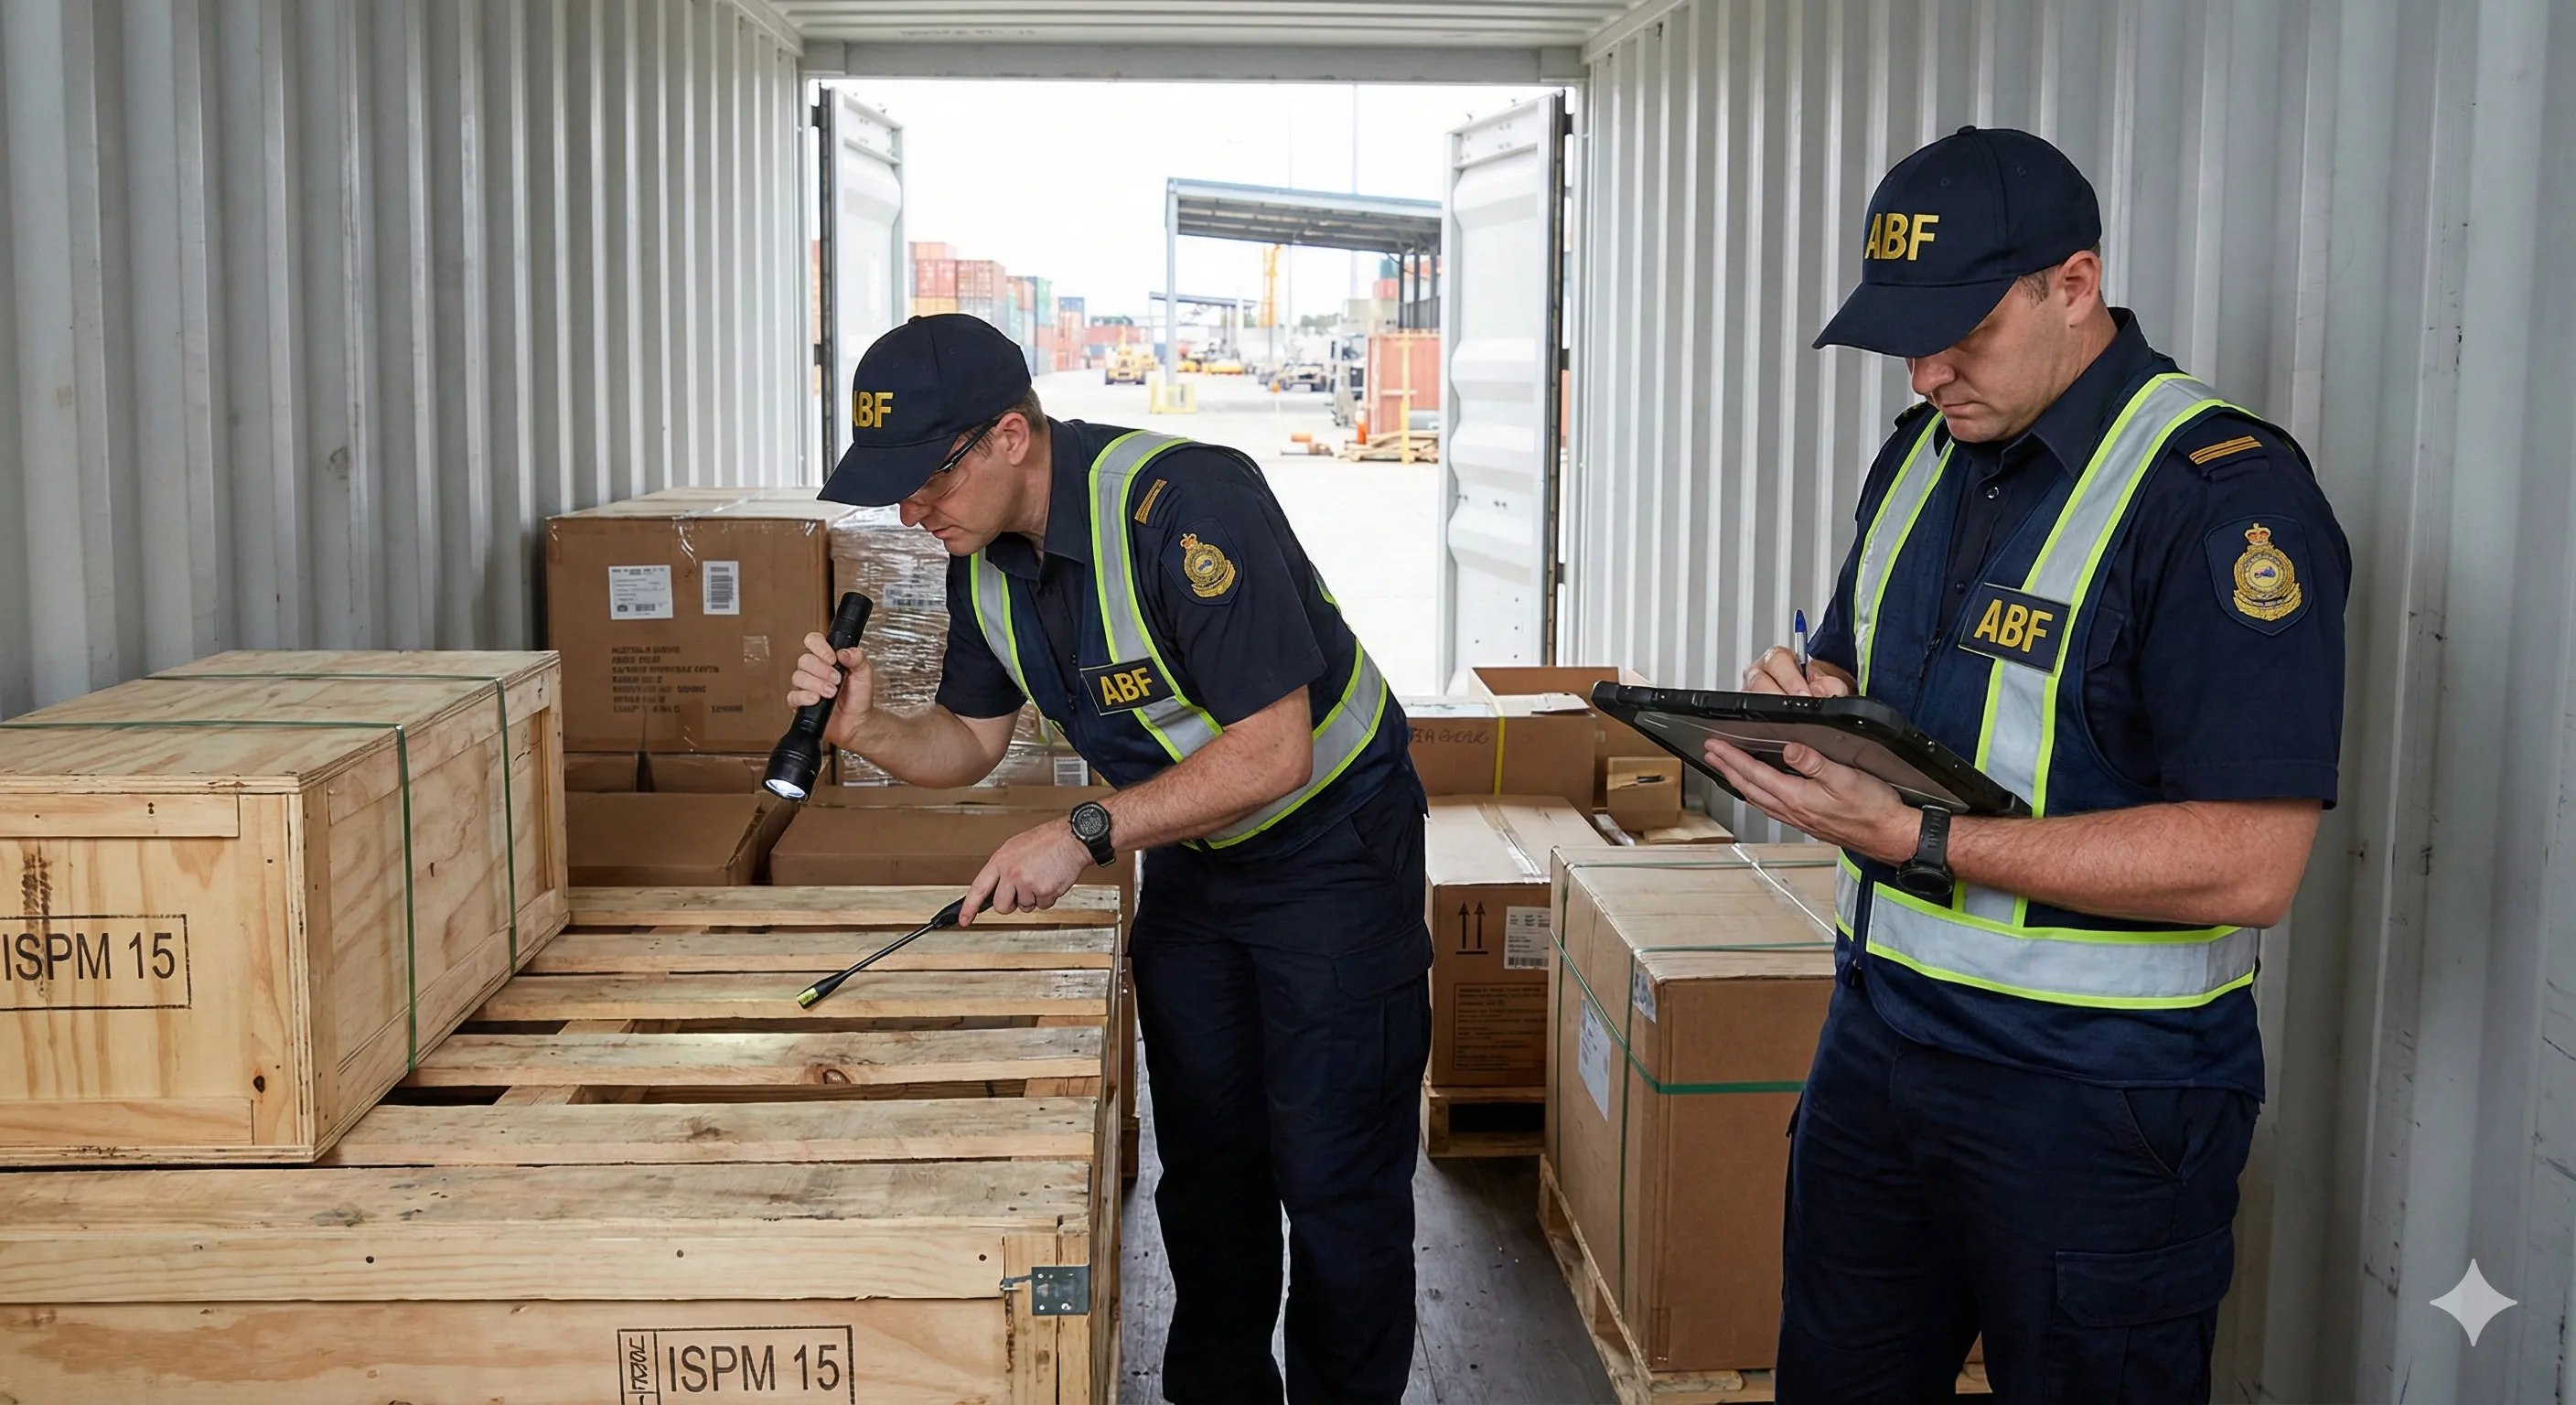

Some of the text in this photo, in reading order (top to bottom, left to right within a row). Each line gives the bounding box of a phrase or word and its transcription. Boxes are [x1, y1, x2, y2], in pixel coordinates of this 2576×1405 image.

[1864, 212, 1939, 261] ABF
[1973, 598, 2054, 653] ABF
[1100, 667, 1153, 705] ABF
[2, 931, 175, 981] ISPM 15
[669, 1345, 776, 1393] ISPM
[793, 1344, 840, 1391] 15
